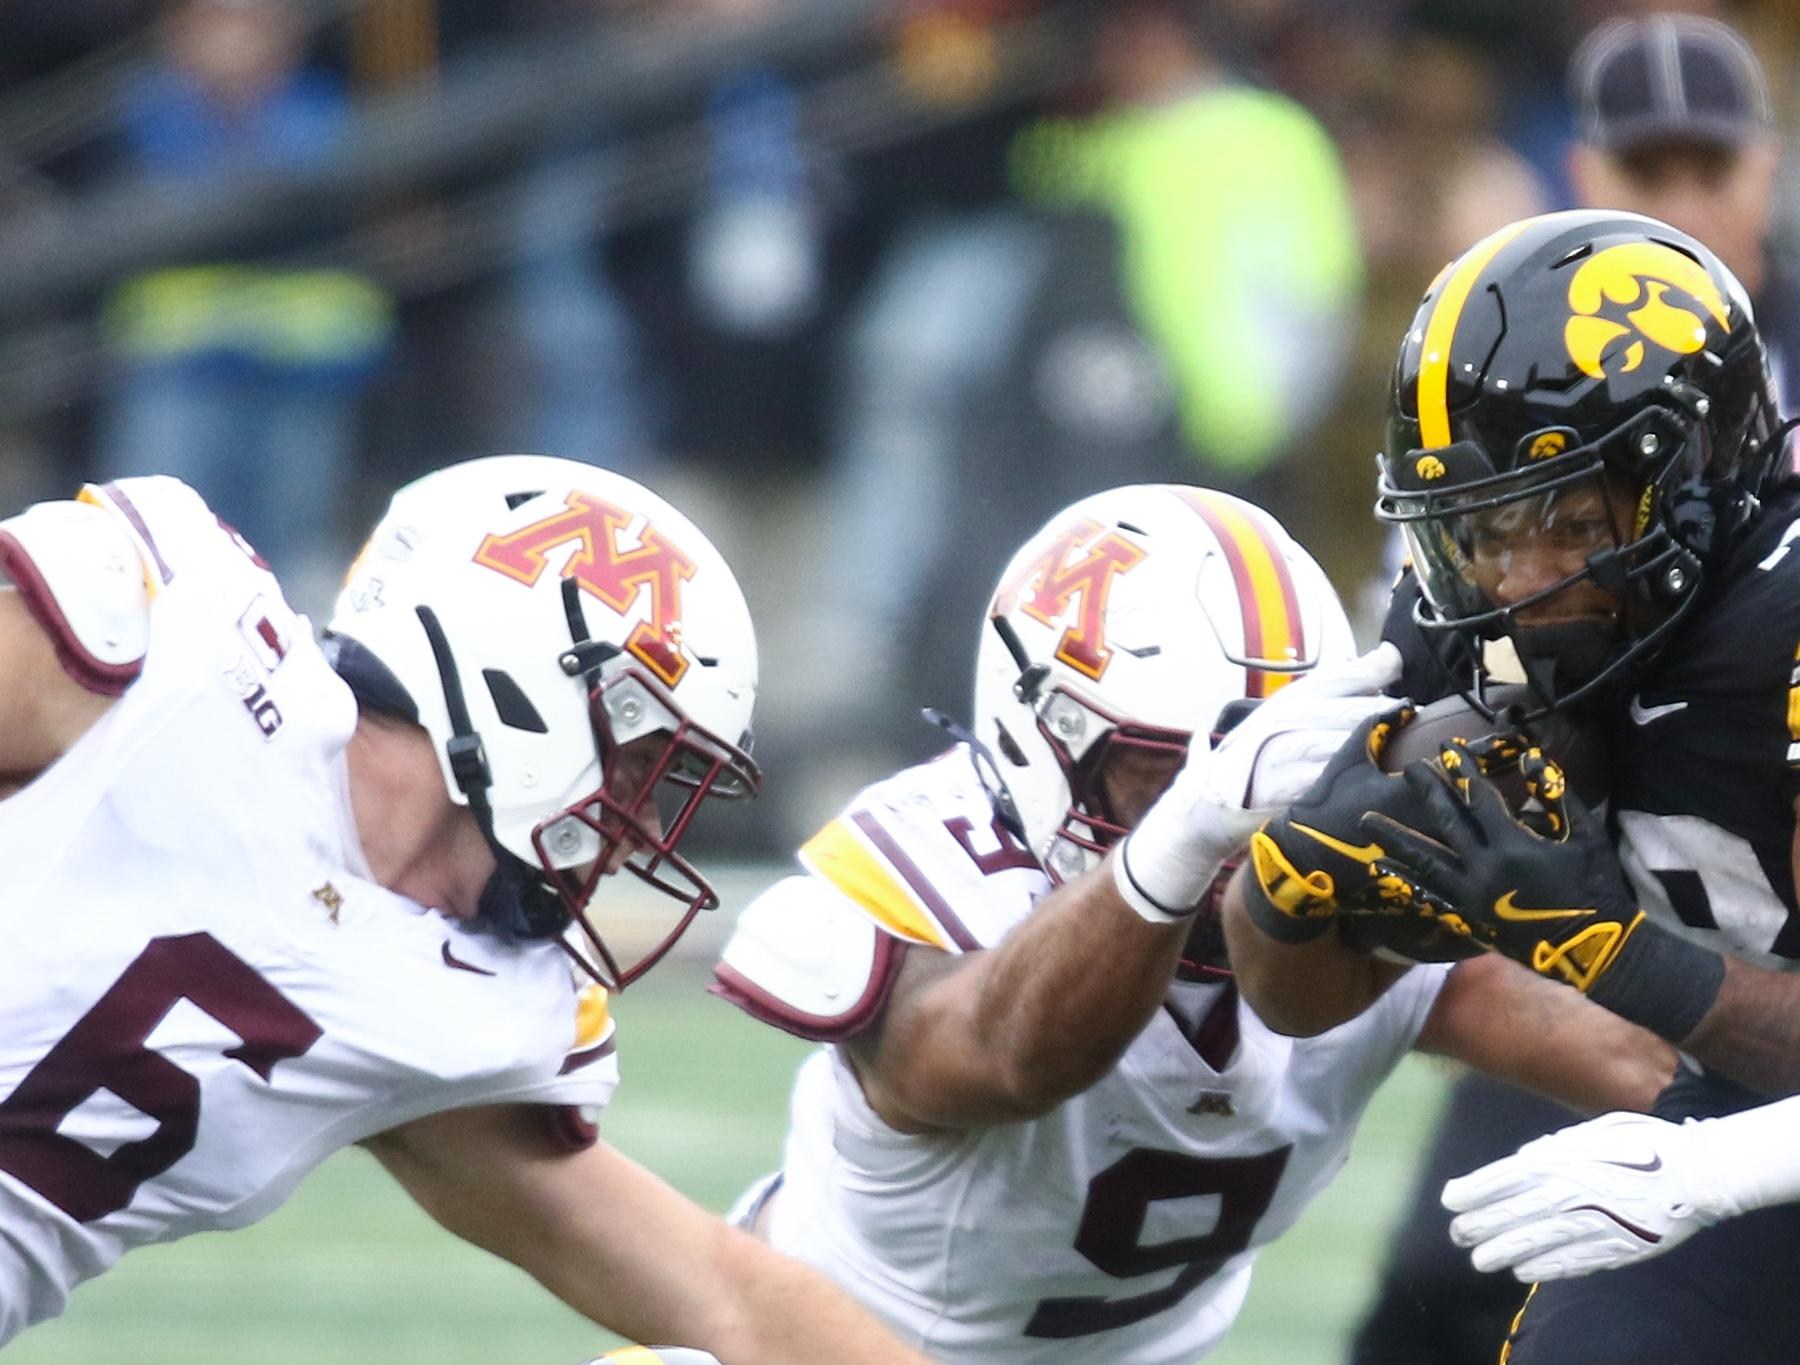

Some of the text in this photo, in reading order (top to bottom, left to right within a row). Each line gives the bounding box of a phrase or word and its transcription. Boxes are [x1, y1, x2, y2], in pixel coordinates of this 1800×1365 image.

[472, 488, 698, 691] M
[992, 517, 1148, 682] M
[0, 931, 325, 1224] 6
[1024, 1144, 1294, 1339] 9
